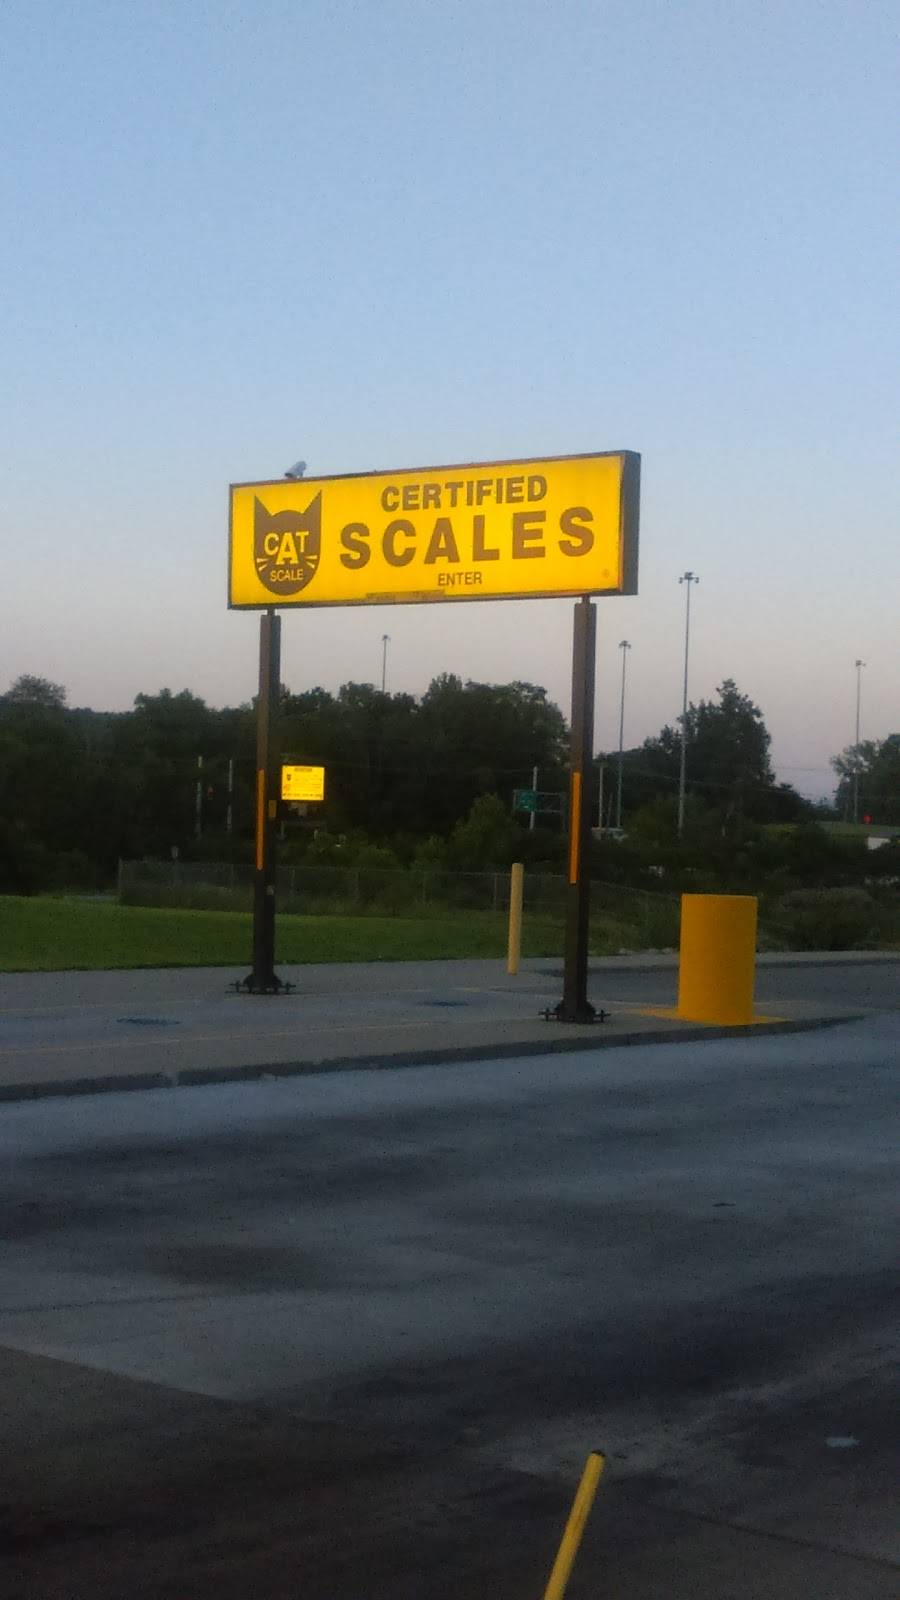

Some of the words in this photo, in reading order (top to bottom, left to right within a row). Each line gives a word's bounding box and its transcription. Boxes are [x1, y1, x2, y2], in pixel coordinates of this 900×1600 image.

[381, 474, 548, 513] CERTIFIED
[264, 531, 309, 564] CAT
[339, 506, 595, 570] SCALES
[270, 569, 304, 582] SCALE
[437, 571, 482, 587] ENTER
